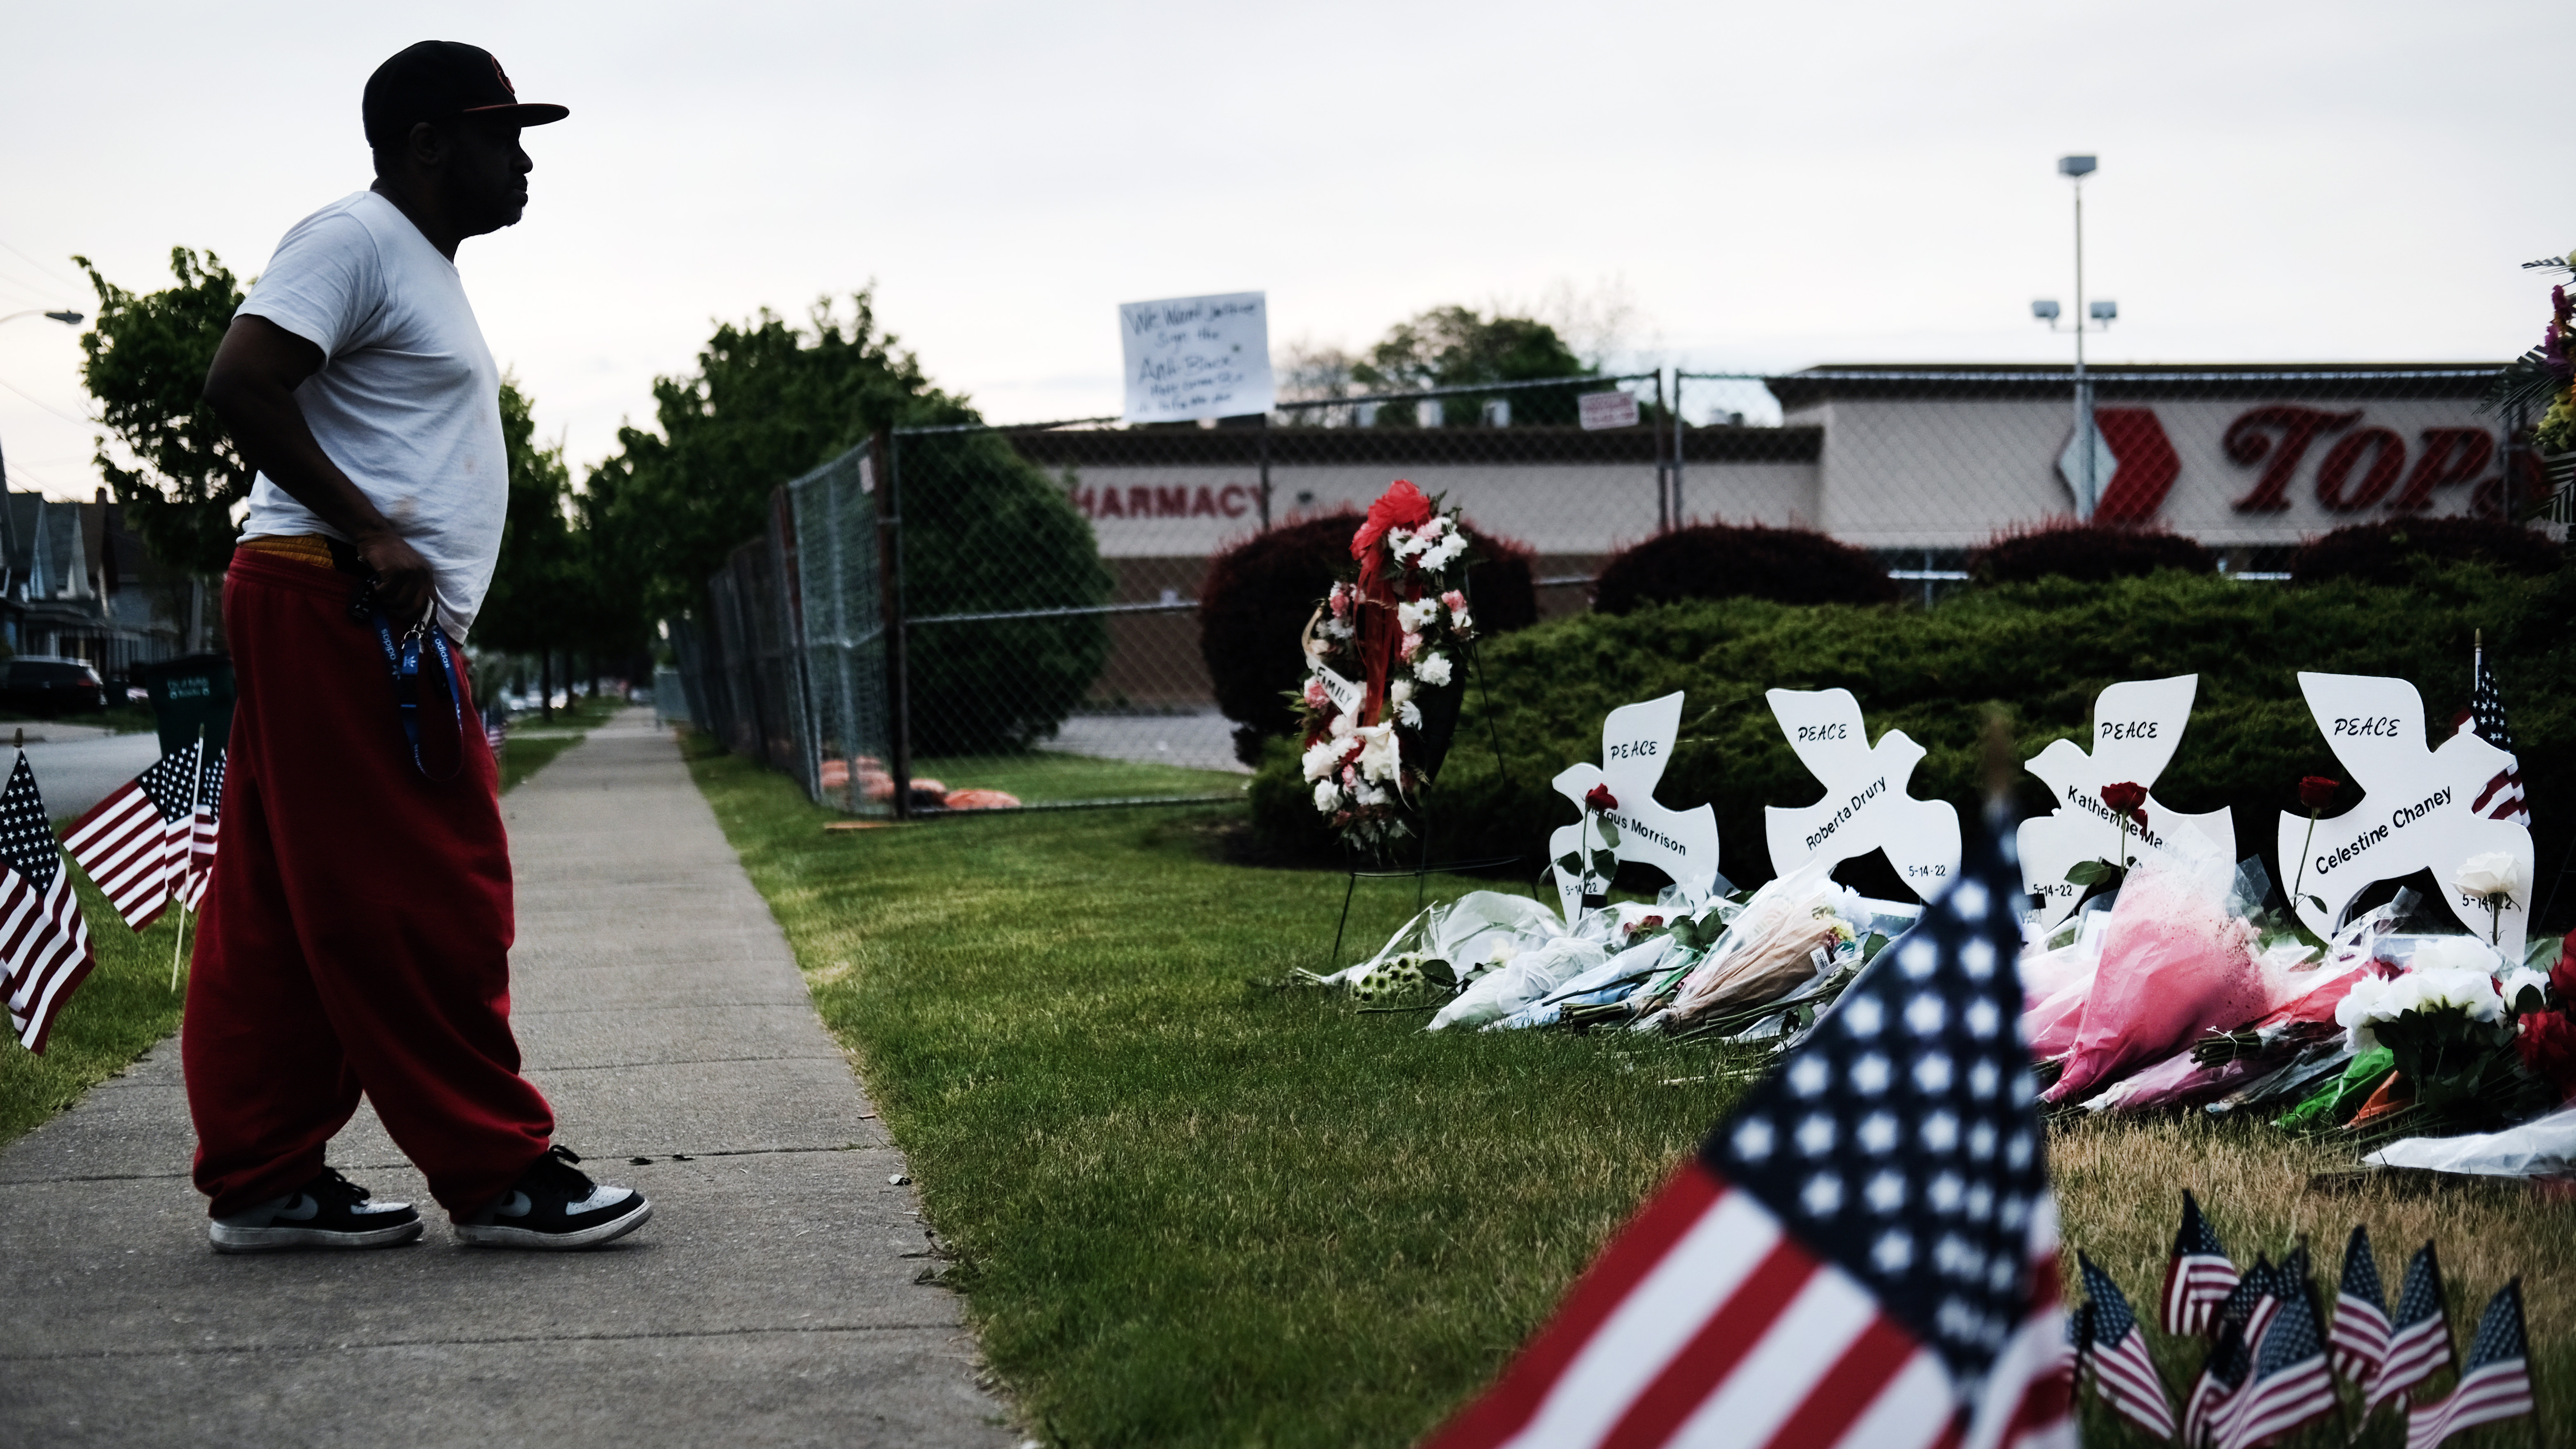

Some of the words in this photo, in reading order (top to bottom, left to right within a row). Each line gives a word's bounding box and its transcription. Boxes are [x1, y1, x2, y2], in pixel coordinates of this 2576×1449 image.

[1070, 483, 1275, 519] HARMACY
[381, 629, 396, 660] adidas
[435, 638, 450, 668] adidas
[1317, 666, 1352, 707] FAMILY
[1798, 723, 1847, 742] PEACE
[2101, 721, 2158, 740] PEACE
[2334, 717, 2401, 737] PEACE
[1610, 741, 1657, 760] PEACE
[1806, 810, 1852, 851] Roberta
[1851, 777, 1886, 812] Drury
[1631, 819, 1686, 856] Morrison
[2316, 824, 2389, 874] Celestine
[2393, 786, 2451, 828] Chaney
[1909, 865, 1946, 877] 5-14-22
[1565, 882, 1598, 896] 5-1422
[2034, 884, 2072, 897] 5-14-22
[2462, 894, 2511, 909] 5-142
